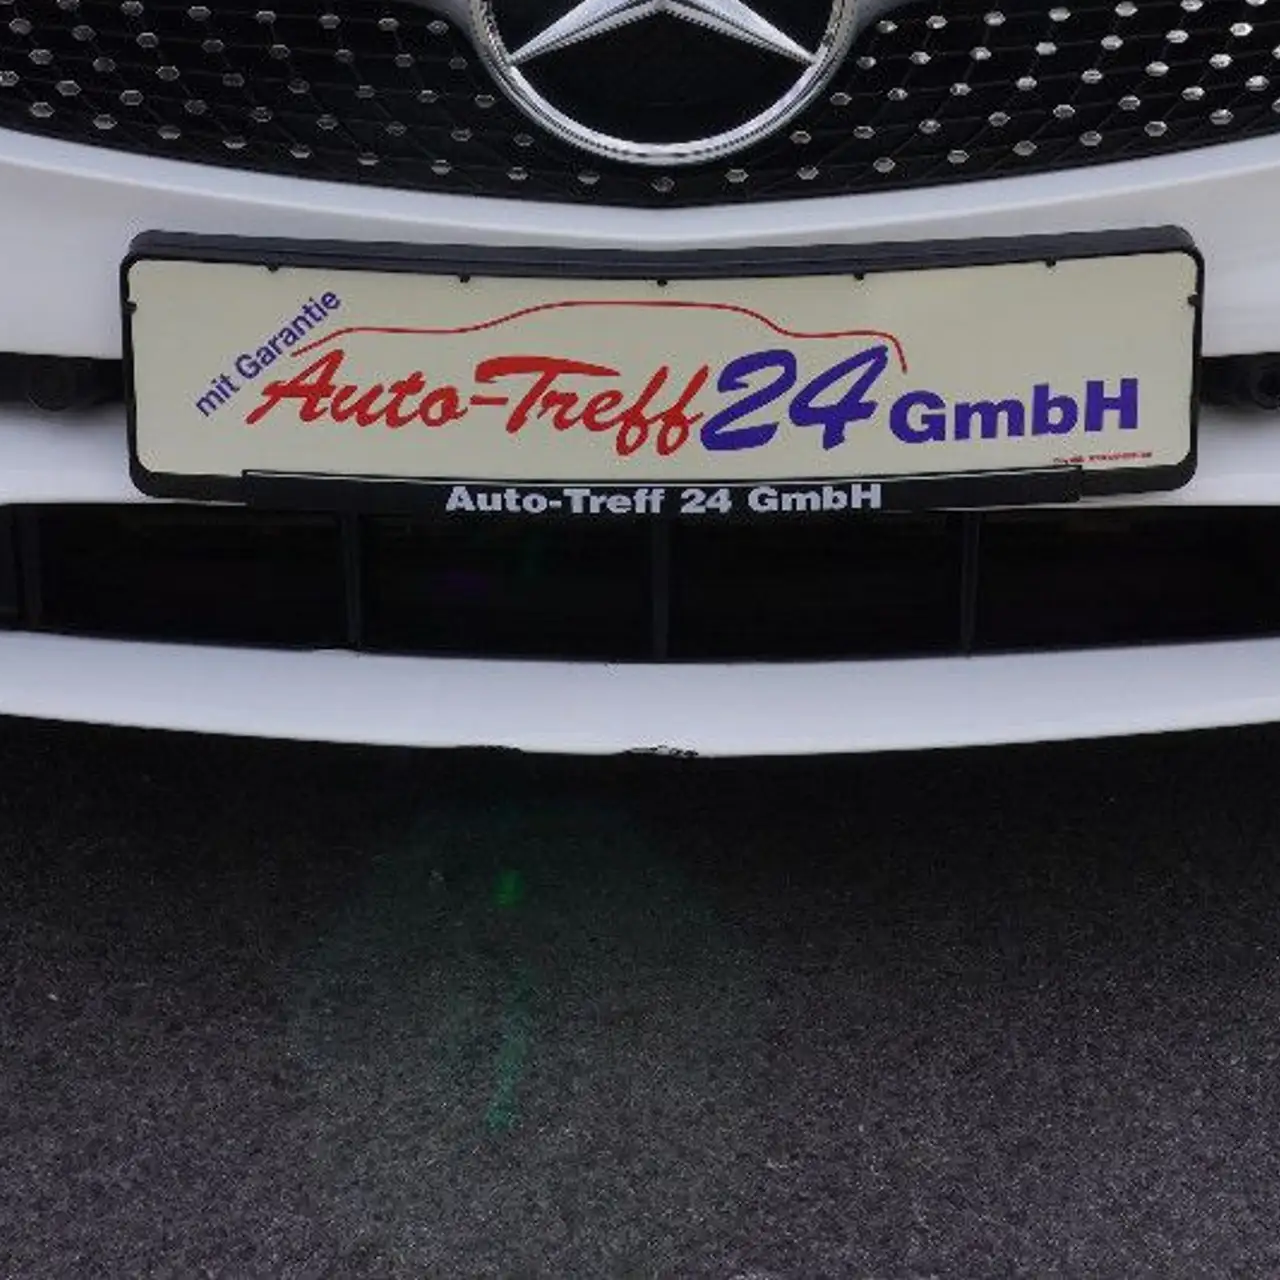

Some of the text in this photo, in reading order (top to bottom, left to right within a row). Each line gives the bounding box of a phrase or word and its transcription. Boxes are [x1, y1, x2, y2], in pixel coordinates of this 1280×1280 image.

[195, 291, 341, 417] mit Garantie
[889, 377, 1140, 443] GmbH
[445, 483, 882, 513] Auto-Treff 24 GmbH
